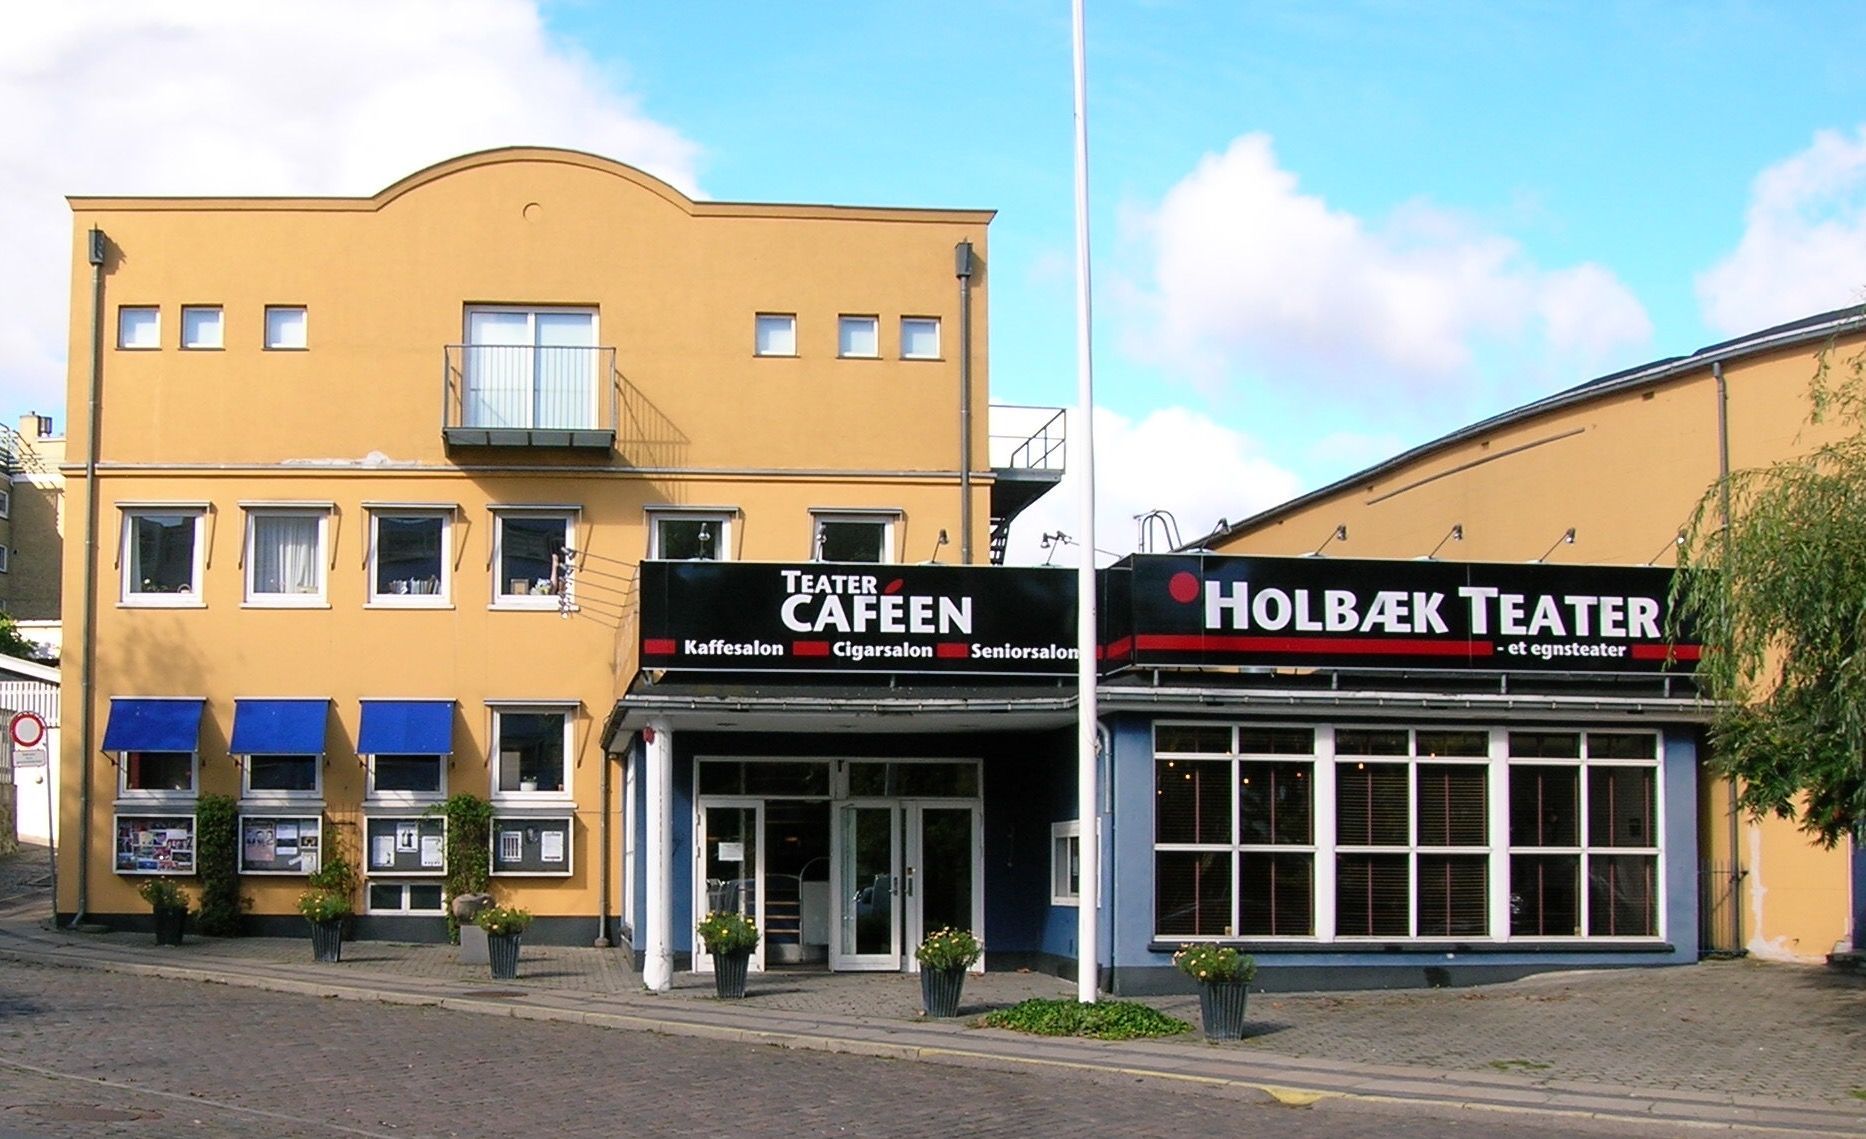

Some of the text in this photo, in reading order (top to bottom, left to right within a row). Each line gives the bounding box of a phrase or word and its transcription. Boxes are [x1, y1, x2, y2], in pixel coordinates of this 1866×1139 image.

[780, 570, 878, 594] TEATER
[1204, 581, 1661, 638] HOLBÆK TEATER
[684, 639, 1080, 660] Kaffesalon Cigarsalon Seniorsalon
[1508, 641, 1527, 656] et
[1530, 643, 1627, 660] egnsteater
